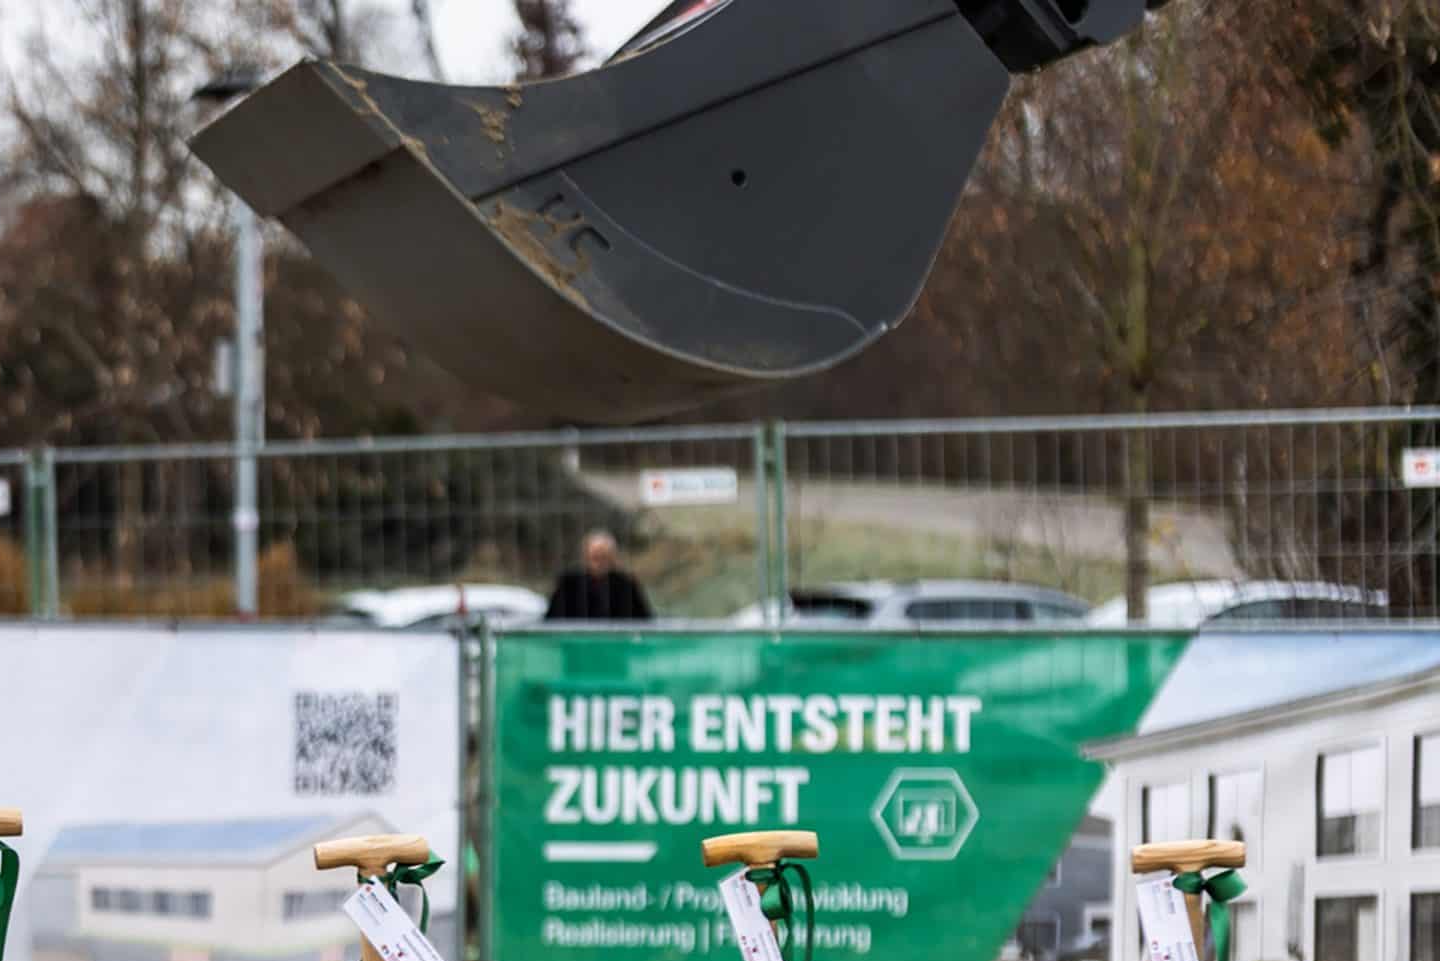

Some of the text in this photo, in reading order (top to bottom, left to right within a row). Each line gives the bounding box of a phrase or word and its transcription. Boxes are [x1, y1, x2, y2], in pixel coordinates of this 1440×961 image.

[549, 694, 981, 752] HIER ENTSTEHT
[544, 766, 810, 824] ZUKUNFT
[545, 918, 695, 951] Realisierung
